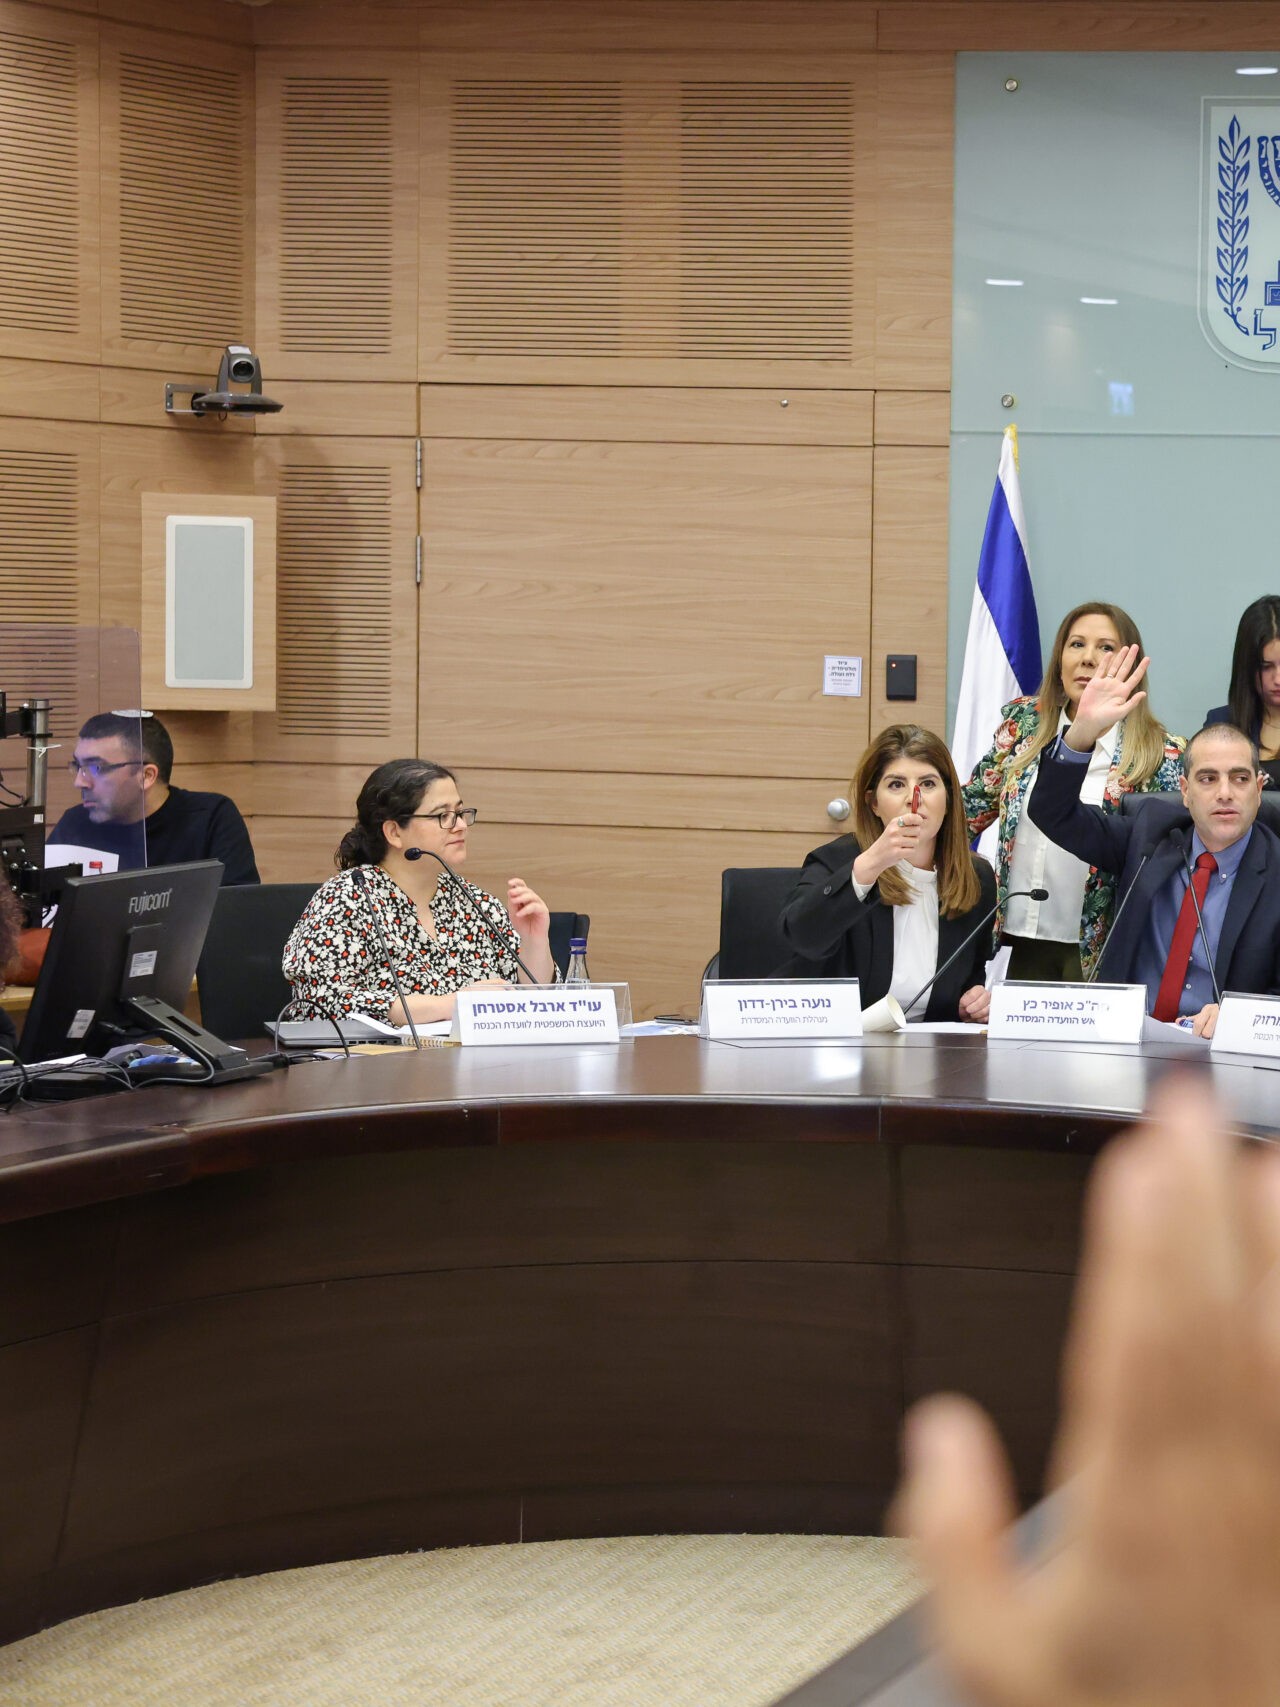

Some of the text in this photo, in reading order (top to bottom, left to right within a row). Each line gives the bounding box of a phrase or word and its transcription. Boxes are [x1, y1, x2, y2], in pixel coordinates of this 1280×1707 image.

[472, 1000, 601, 1017] עו"ד ארבל אסטרחן
[737, 998, 832, 1012] נועה בירן-דדון
[1023, 999, 1038, 1012] כץ
[1041, 1000, 1073, 1011] אופיר
[473, 1019, 606, 1030] היועצת המשפטית לוועדת הכנסת
[741, 1016, 774, 1025] המסדרת
[802, 1014, 828, 1024] מנהלת
[1006, 1014, 1045, 1024] המסדרת
[1047, 1015, 1079, 1025] הוועדה
